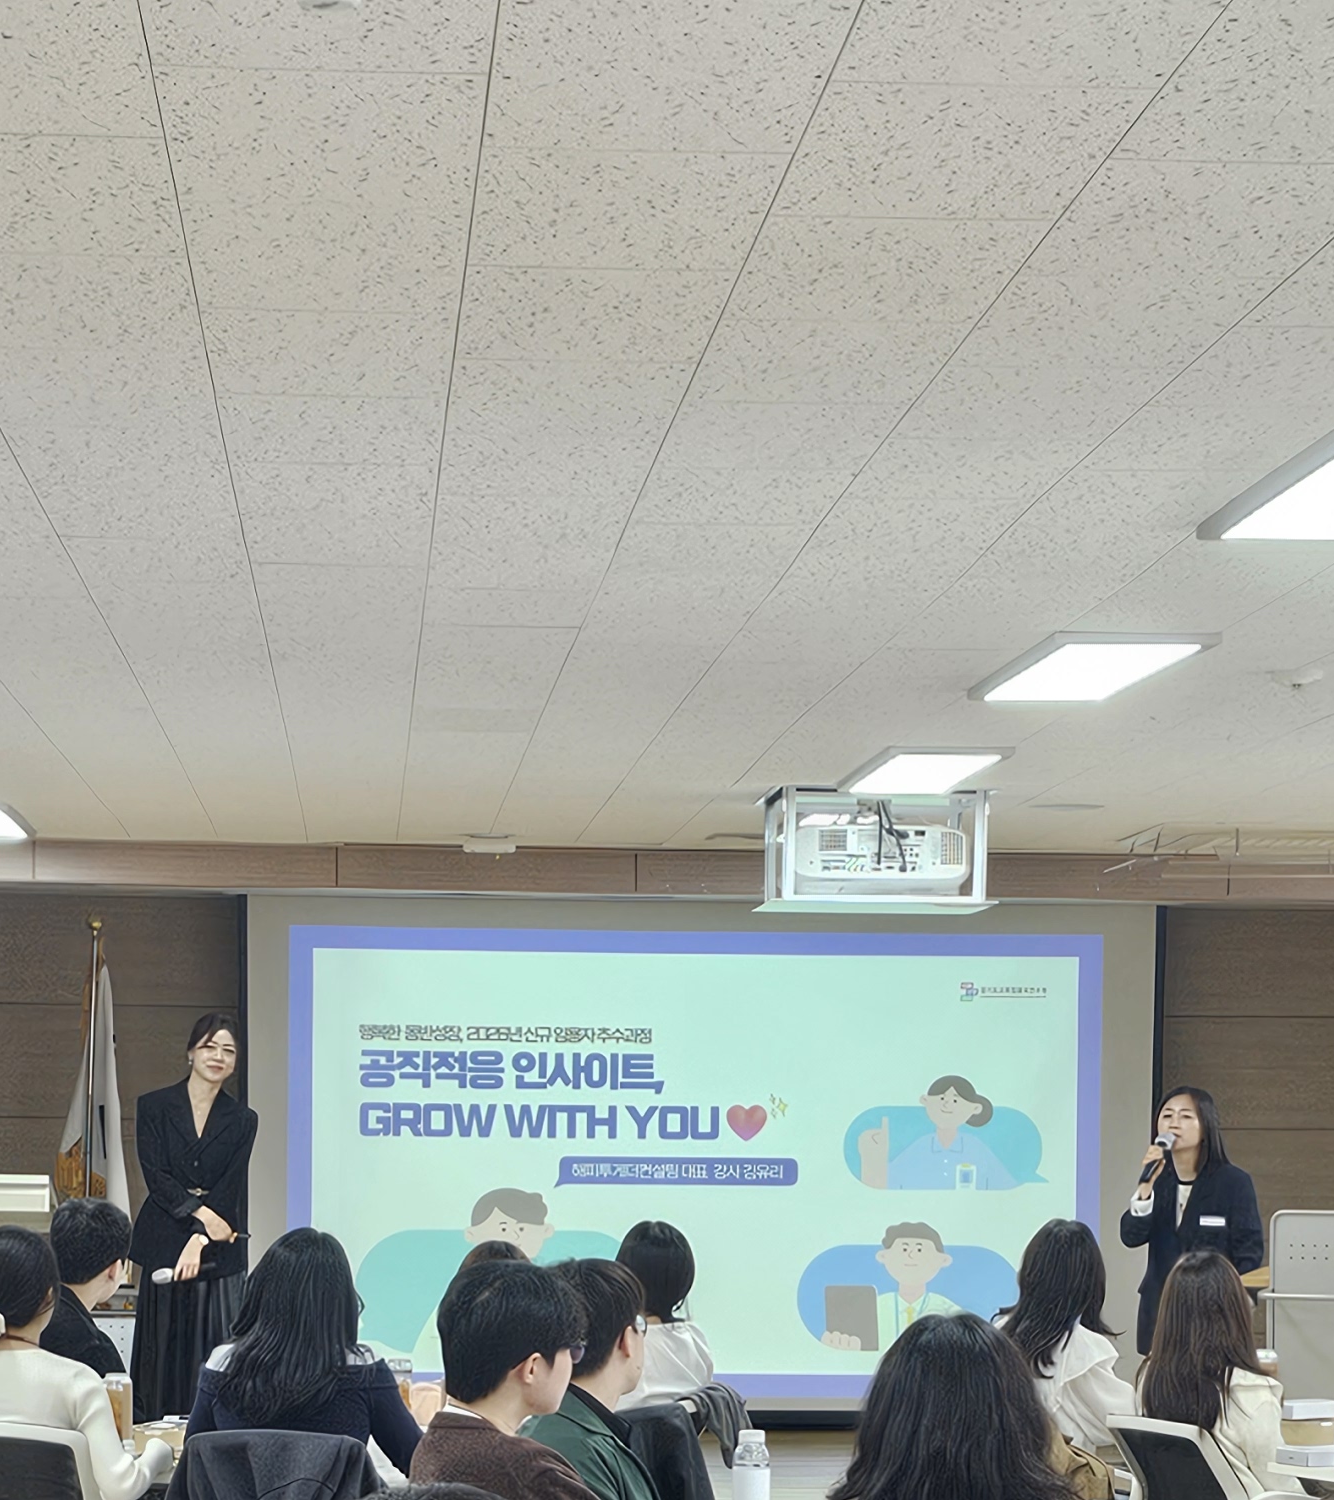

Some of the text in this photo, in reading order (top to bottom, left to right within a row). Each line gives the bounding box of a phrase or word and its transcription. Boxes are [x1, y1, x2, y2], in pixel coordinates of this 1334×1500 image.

[523, 1026, 552, 1043] 신규
[359, 1049, 665, 1095] 공직적응 인사이트,
[359, 1102, 720, 1140] GROW WITH YOU
